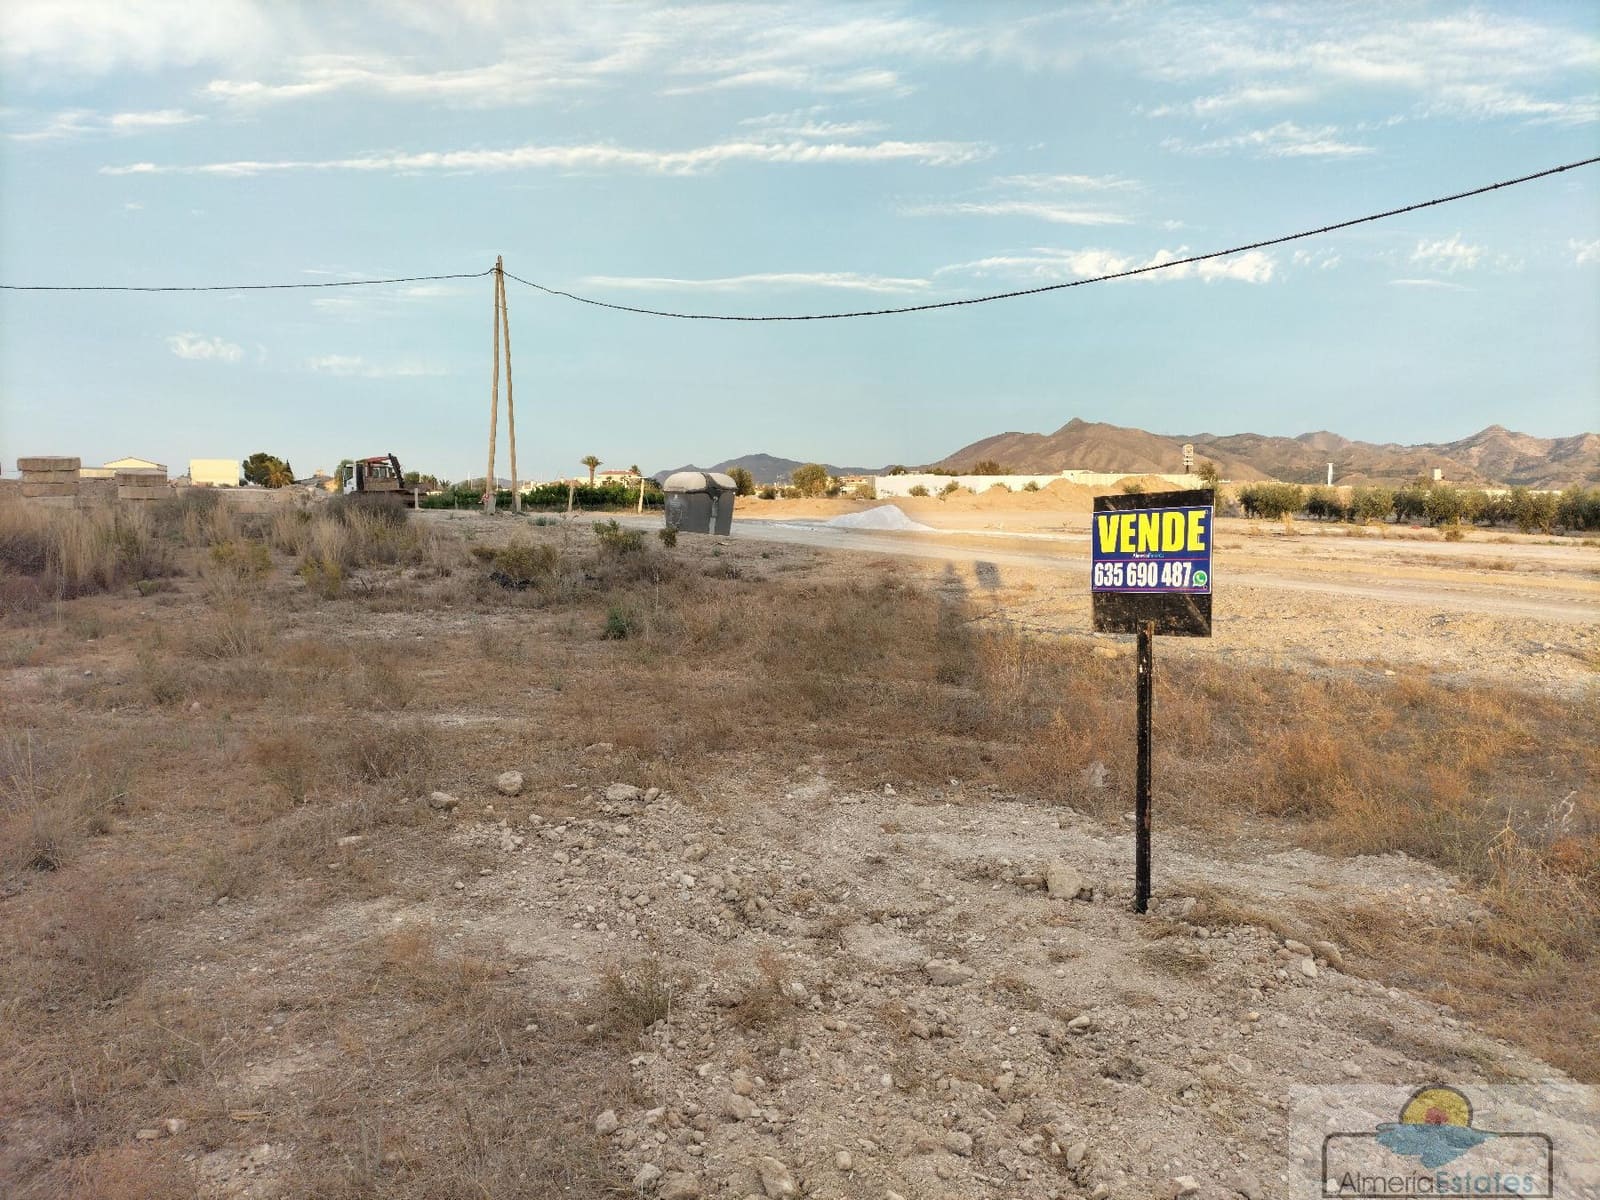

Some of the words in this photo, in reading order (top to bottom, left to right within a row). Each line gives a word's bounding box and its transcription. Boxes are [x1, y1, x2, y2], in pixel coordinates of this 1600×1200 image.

[1097, 511, 1206, 553] VENDE
[1094, 562, 1123, 587] 635
[1126, 562, 1158, 587] 690
[1161, 562, 1192, 587] 487
